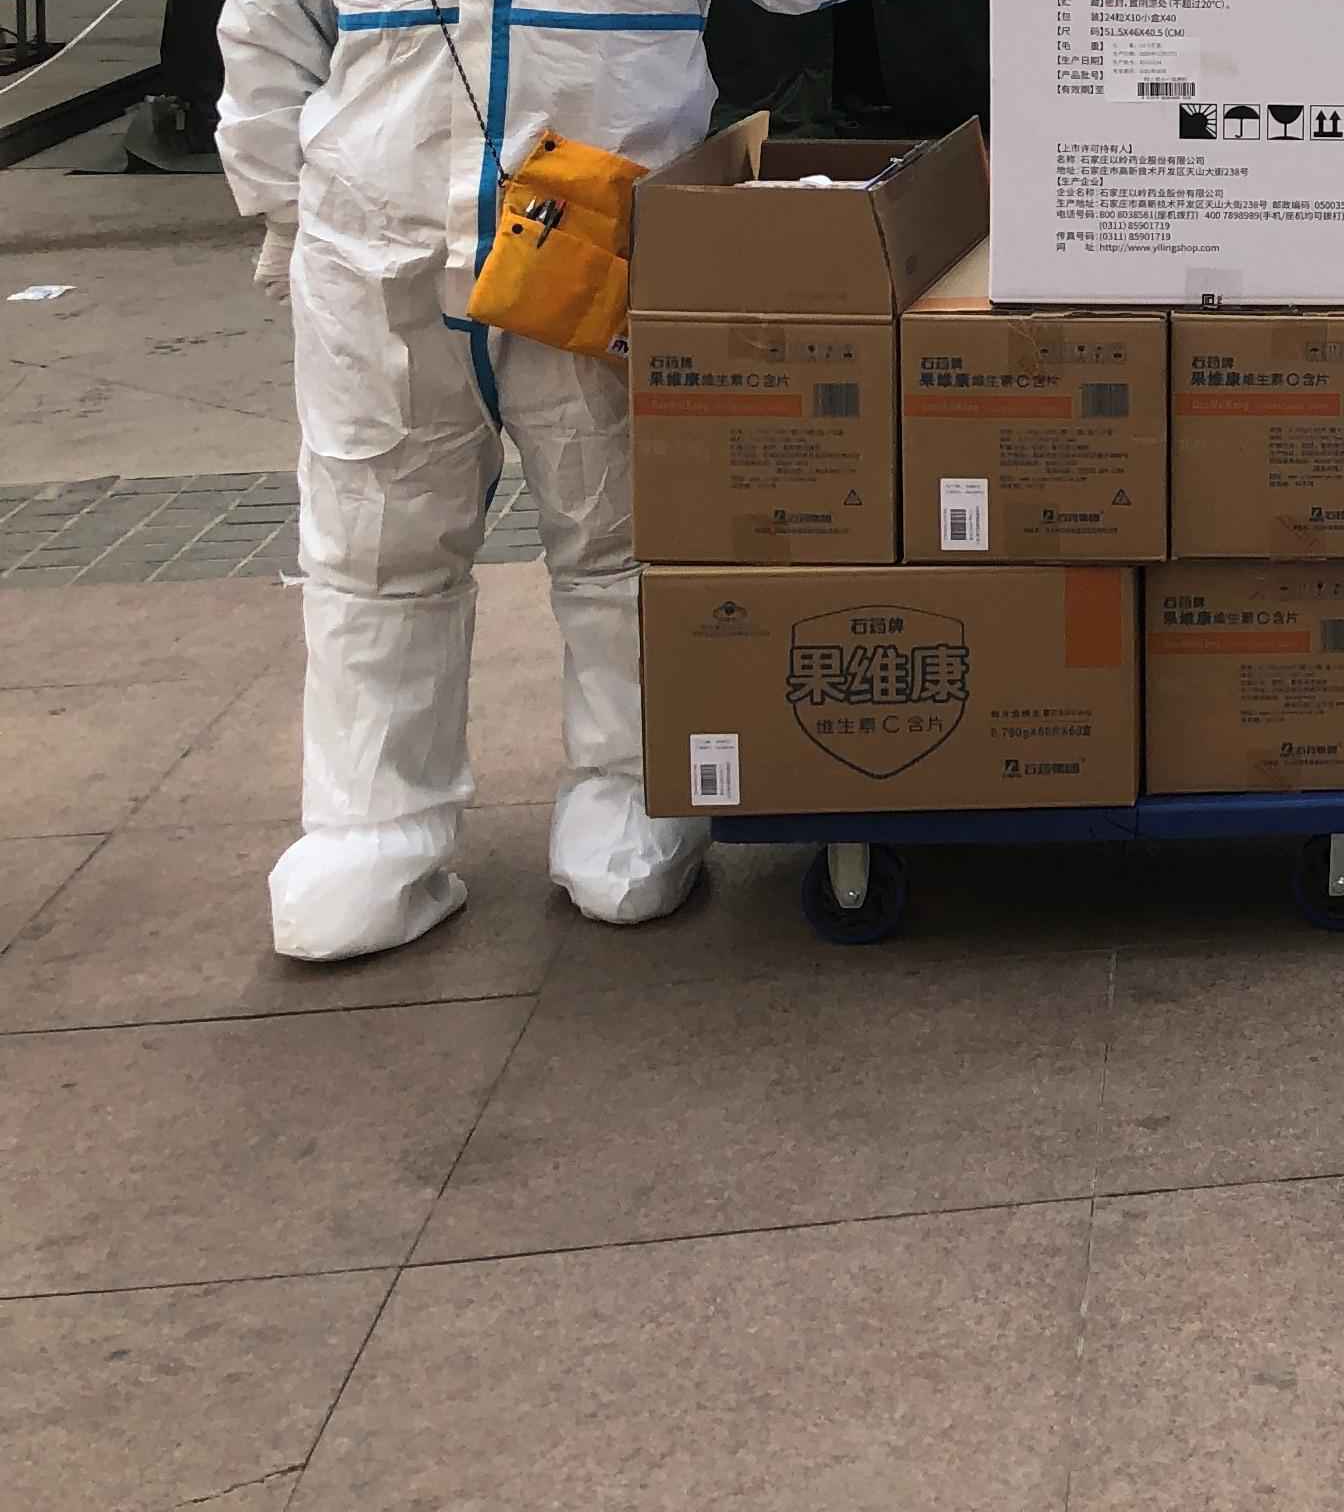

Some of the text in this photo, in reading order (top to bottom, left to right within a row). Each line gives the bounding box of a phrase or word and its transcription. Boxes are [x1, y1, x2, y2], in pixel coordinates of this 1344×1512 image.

[851, 617, 905, 635] 石药牌
[787, 643, 970, 705] 果维康
